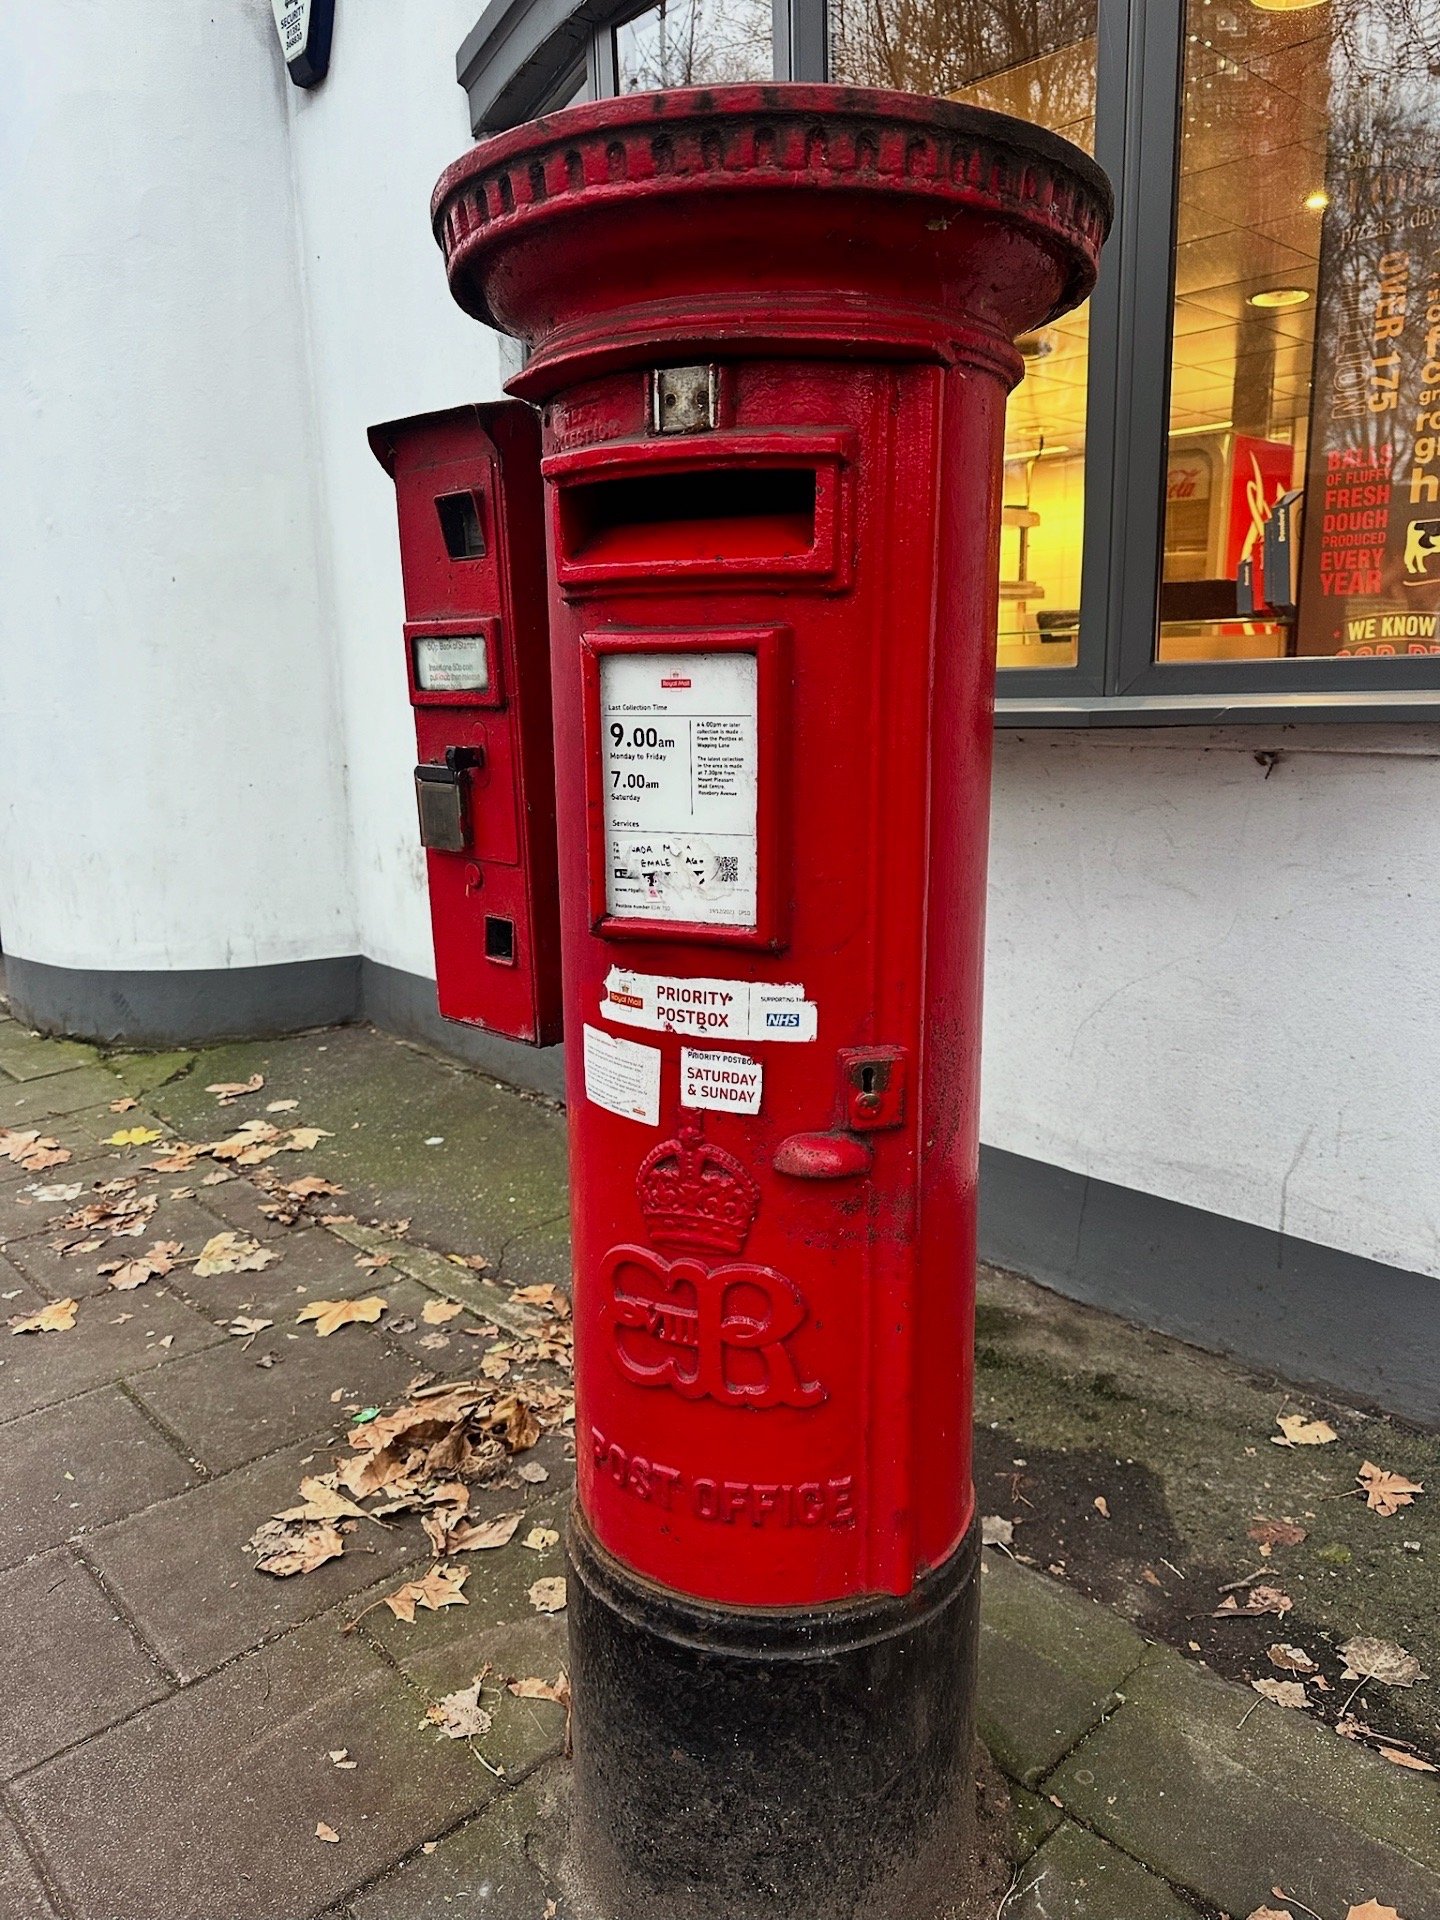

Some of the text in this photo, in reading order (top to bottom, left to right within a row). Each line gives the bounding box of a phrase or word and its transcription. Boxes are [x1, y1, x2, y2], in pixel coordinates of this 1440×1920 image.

[1369, 250, 1409, 412] OVER 175
[1327, 443, 1393, 472] BALLS
[1326, 467, 1391, 486] OF FLUFFY
[1325, 484, 1391, 510] FRESH
[1323, 509, 1388, 533] DOUGH
[1321, 531, 1386, 548] PRODUCED
[1320, 548, 1384, 571] EVERY
[1319, 569, 1382, 596] YEAR
[1348, 615, 1437, 641] WE KNOW
[622, 703, 651, 711] Collection
[610, 722, 675, 748] 9.00am
[610, 752, 635, 761] Monday
[646, 752, 666, 761] Friday
[610, 771, 659, 788] 7.00am
[611, 793, 641, 802] Saturday
[612, 820, 640, 828] Services
[610, 992, 642, 1007] Royal Mail
[657, 986, 729, 1006] PRIORITY
[657, 1007, 728, 1028] POSTBOX
[767, 1014, 799, 1026] NHS
[687, 1051, 720, 1062] PRIORITY
[687, 1067, 757, 1086] SATURDAY
[687, 1084, 755, 1103] & SUNDAY
[592, 1426, 682, 1513] POST
[694, 1475, 854, 1532] OFFICE
